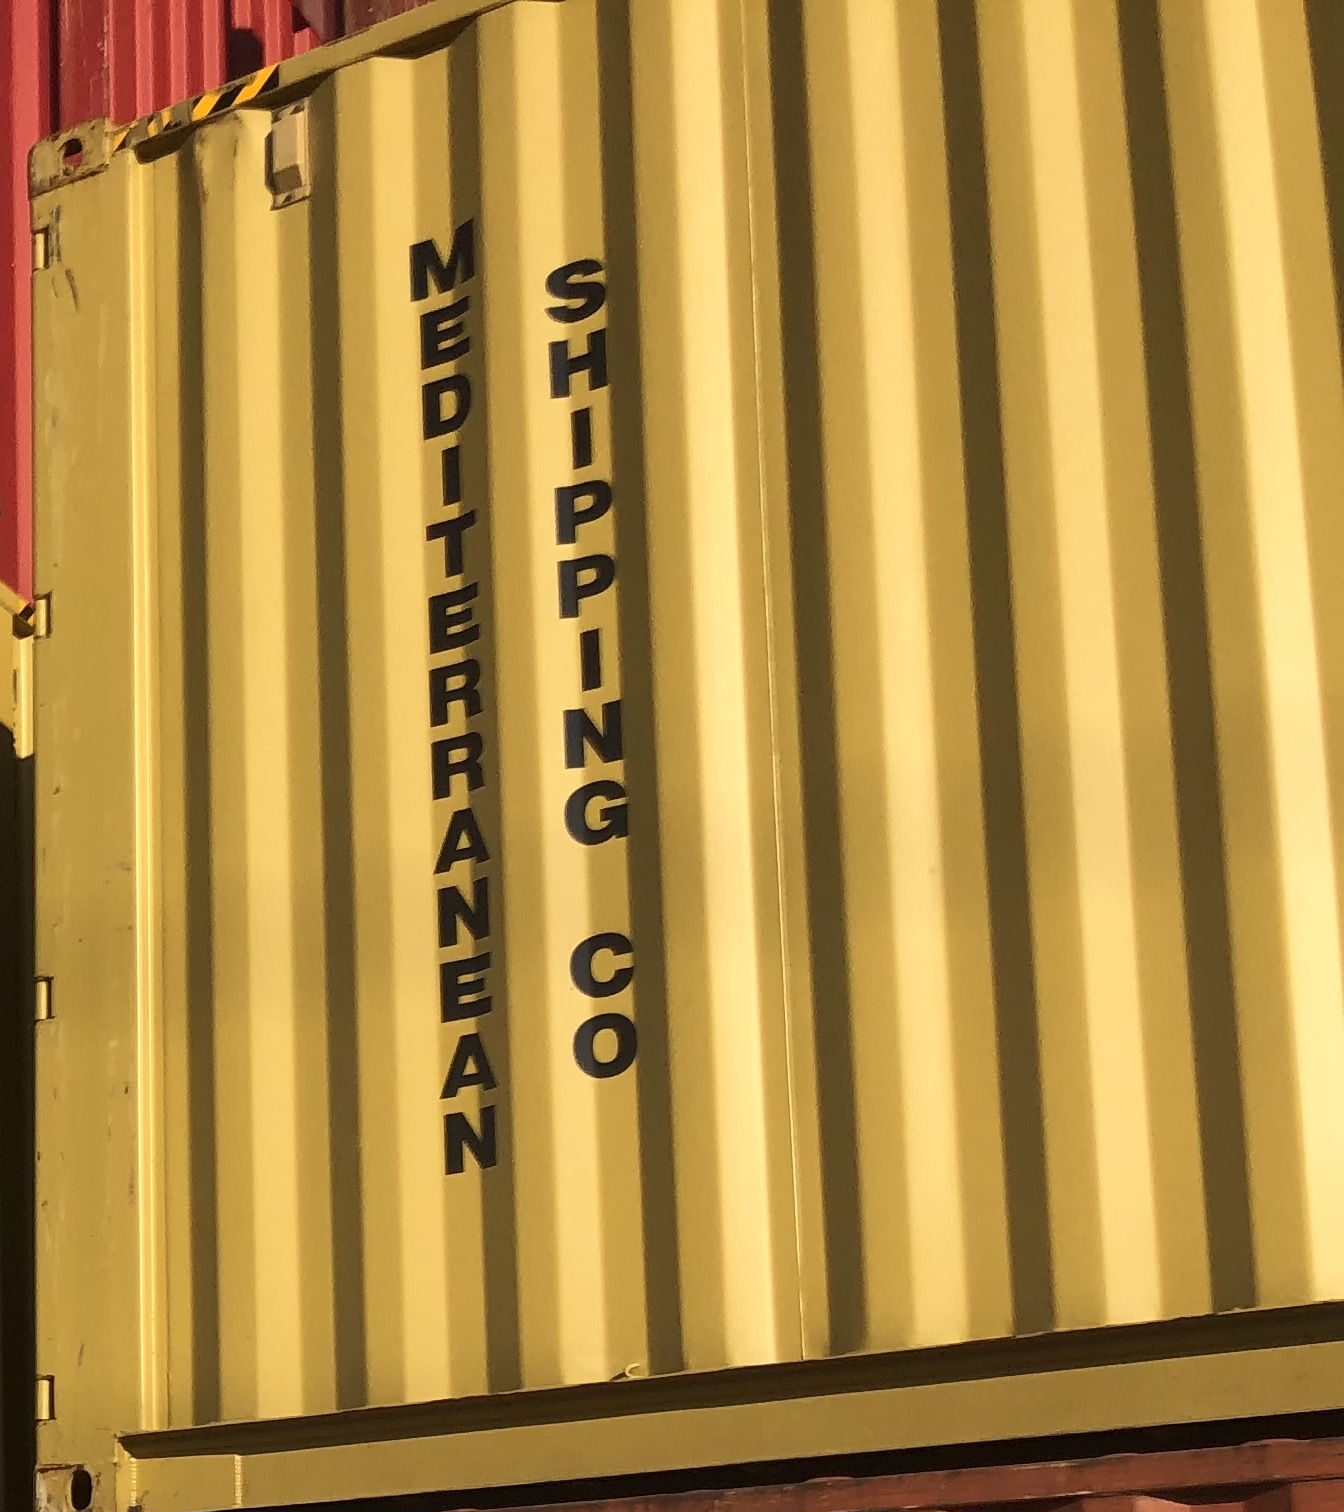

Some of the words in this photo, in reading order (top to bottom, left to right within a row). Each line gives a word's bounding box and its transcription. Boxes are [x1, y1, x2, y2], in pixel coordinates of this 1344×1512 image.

[409, 216, 500, 1176] MEDITERRANEAN
[544, 258, 631, 848] SHIPPING
[568, 931, 639, 1081] CO
